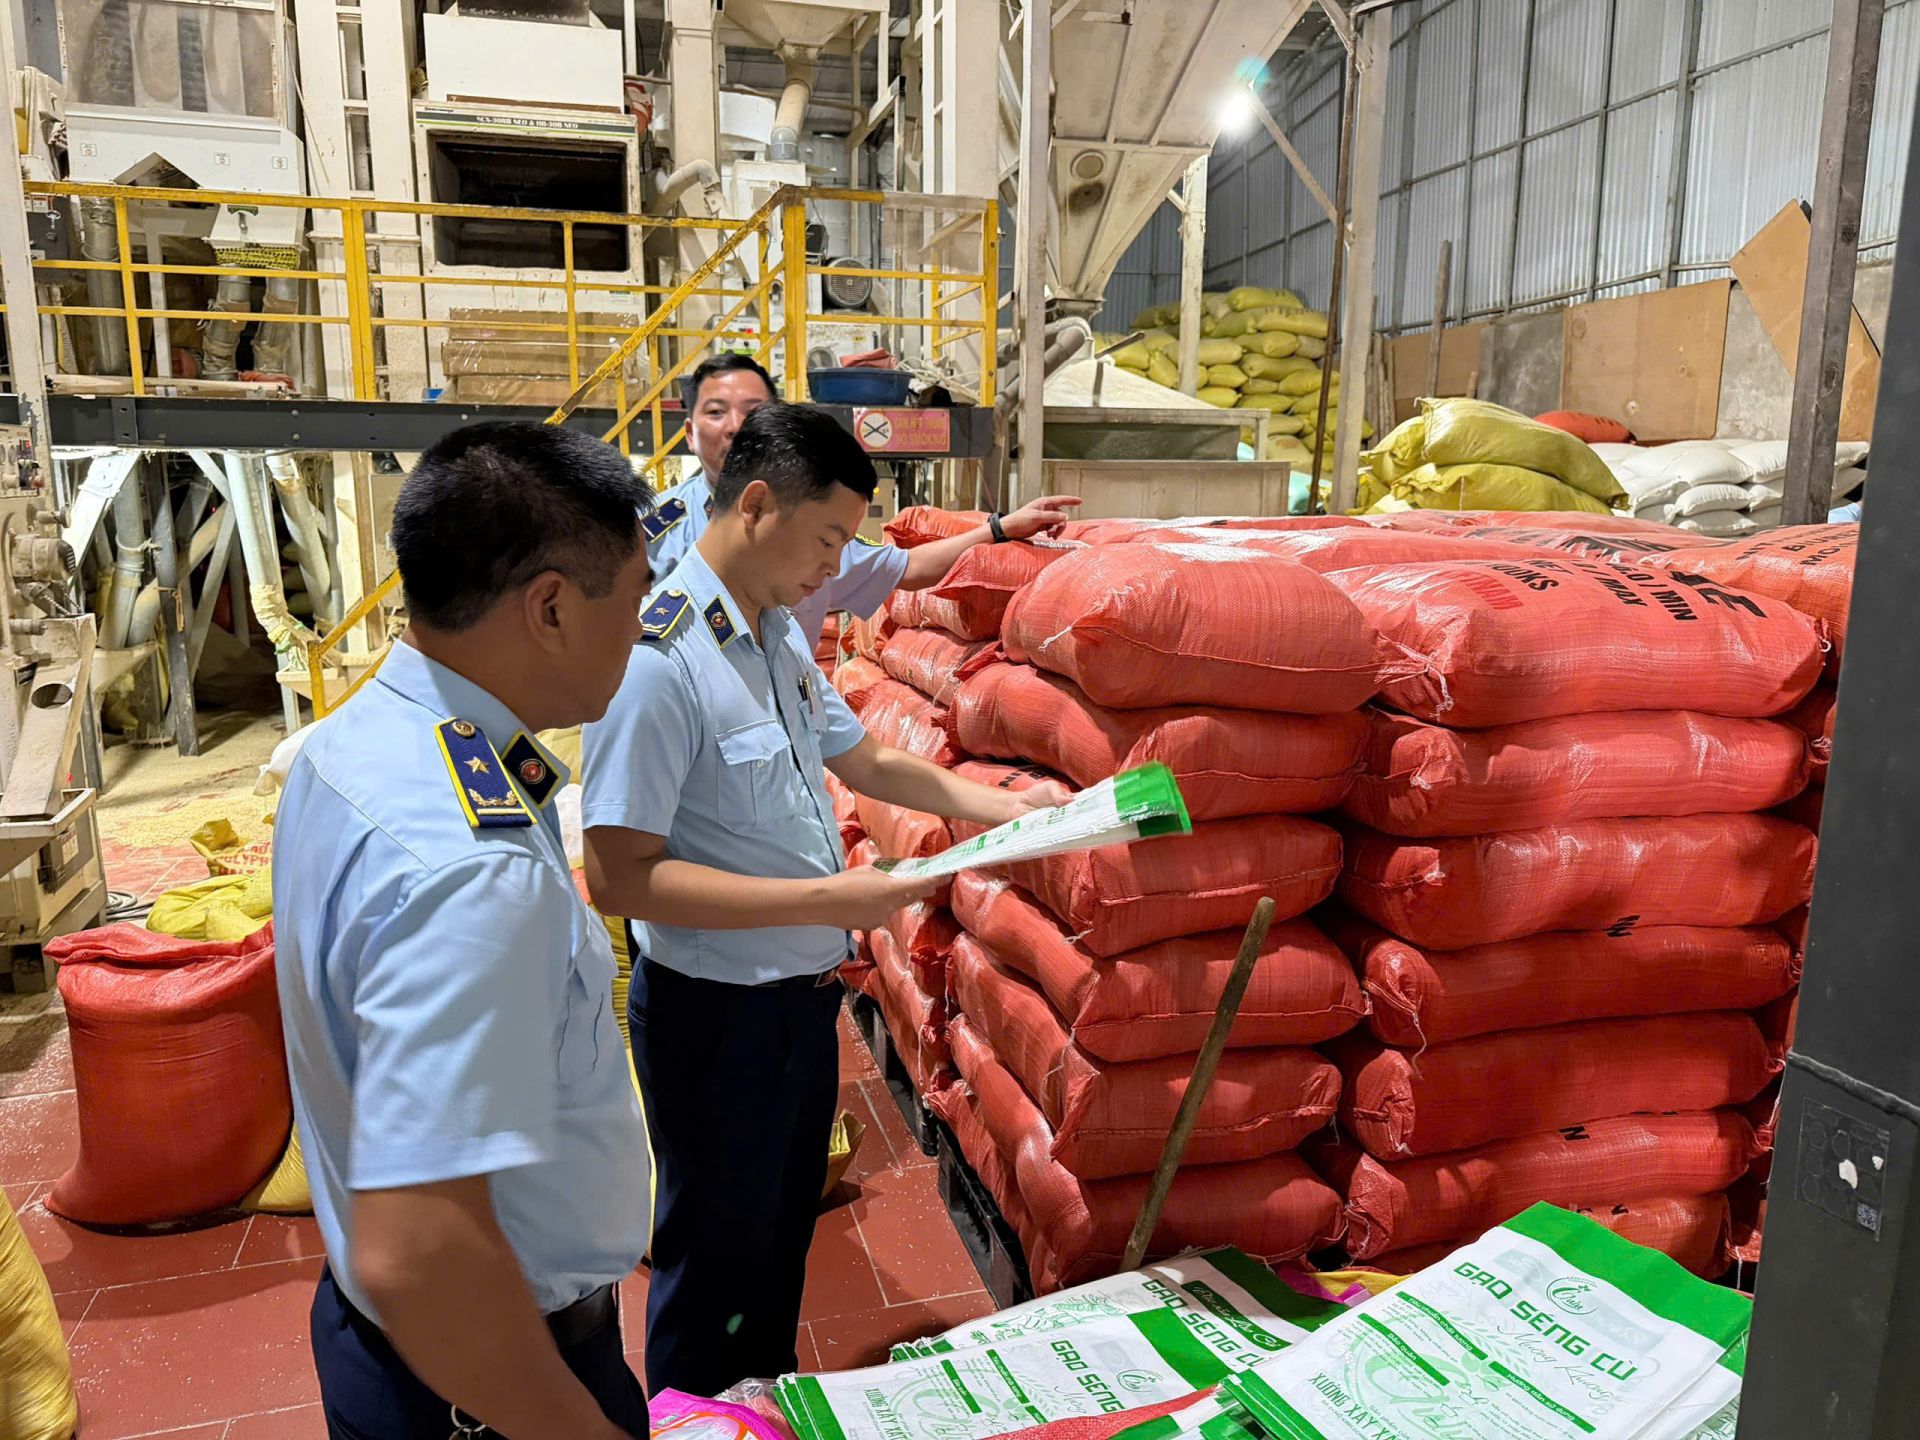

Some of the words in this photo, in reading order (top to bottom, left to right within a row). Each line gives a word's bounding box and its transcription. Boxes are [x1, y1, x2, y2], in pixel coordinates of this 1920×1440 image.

[1141, 1279, 1189, 1310] GẠO
[1453, 1262, 1513, 1300] GẠO
[1590, 1352, 1638, 1381] CÙ
[1051, 1340, 1088, 1371] GẠO
[1344, 1403, 1378, 1431] XAY
